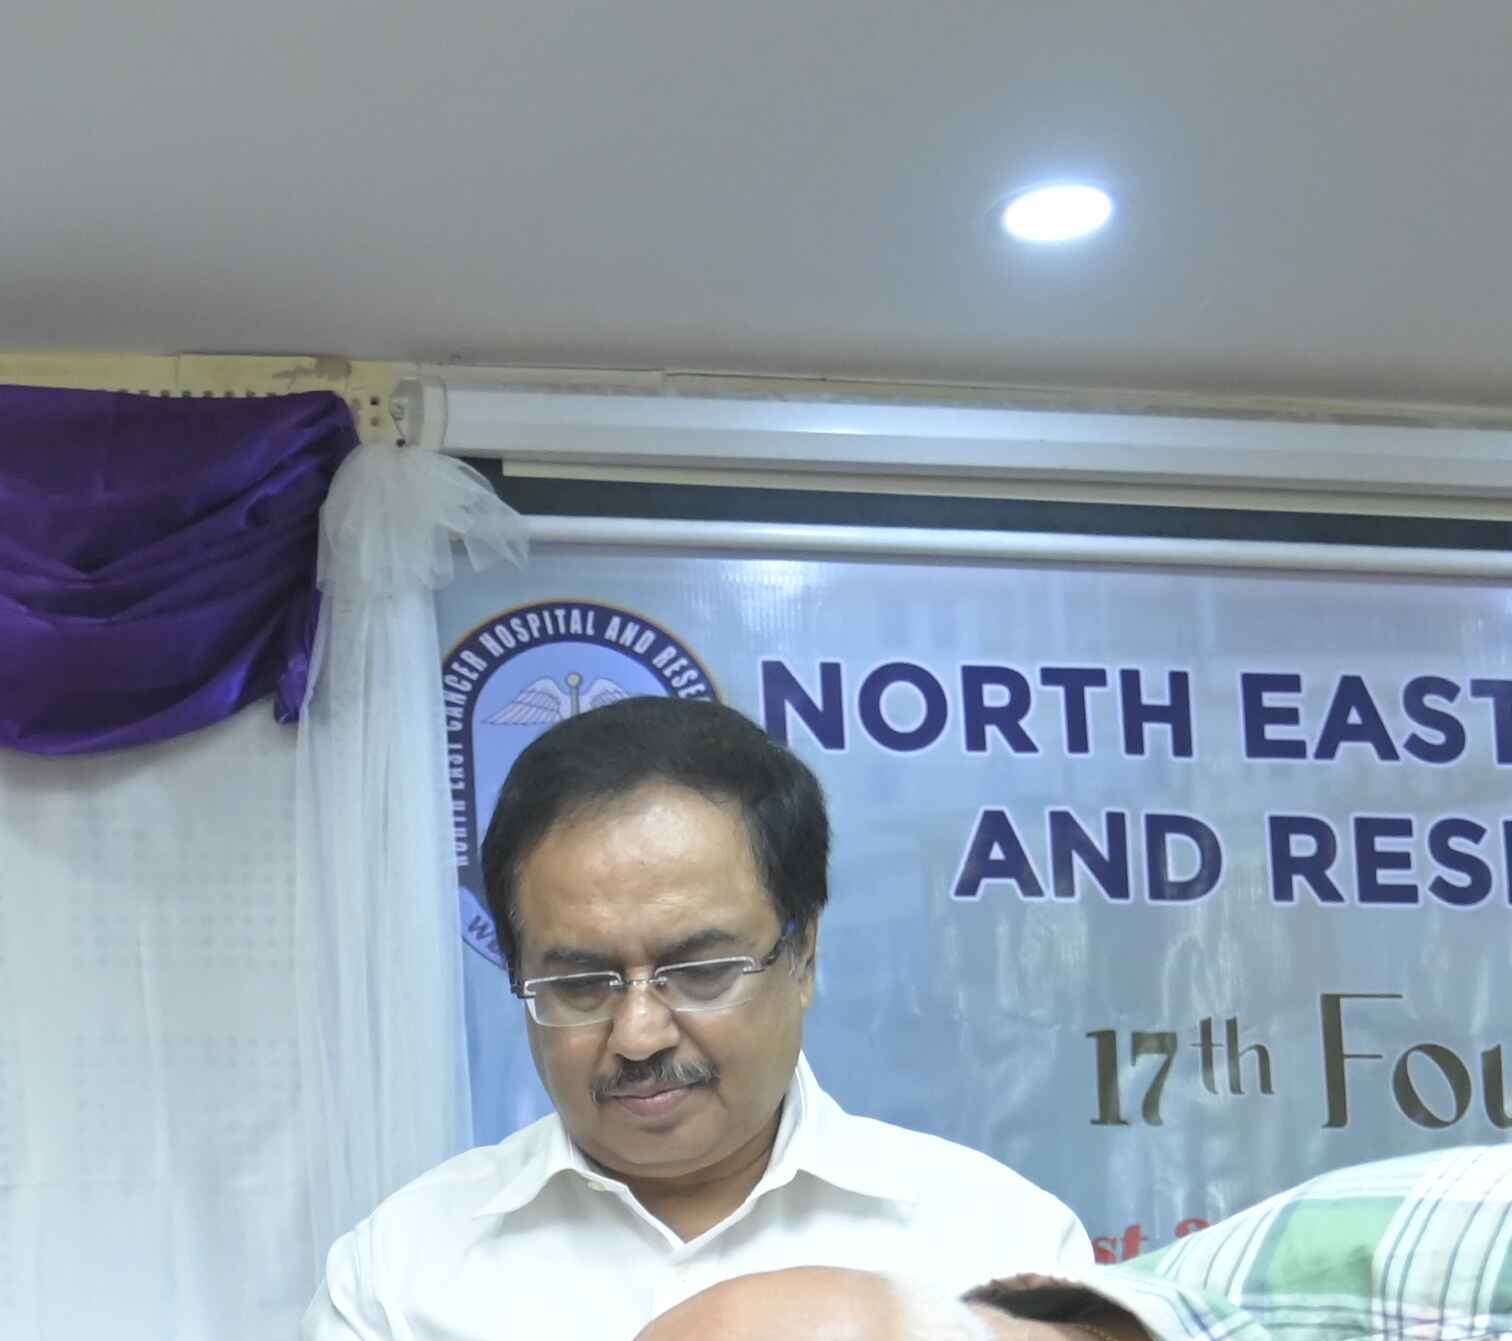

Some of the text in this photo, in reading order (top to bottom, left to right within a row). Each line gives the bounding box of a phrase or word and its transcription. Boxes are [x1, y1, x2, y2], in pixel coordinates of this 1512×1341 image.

[478, 607, 595, 657] HOSPITAL
[604, 615, 656, 653] AND
[652, 646, 712, 702] RESE
[761, 660, 1193, 758] NORTH
[952, 810, 1223, 901] AND
[1085, 1016, 1275, 1127] 17th
